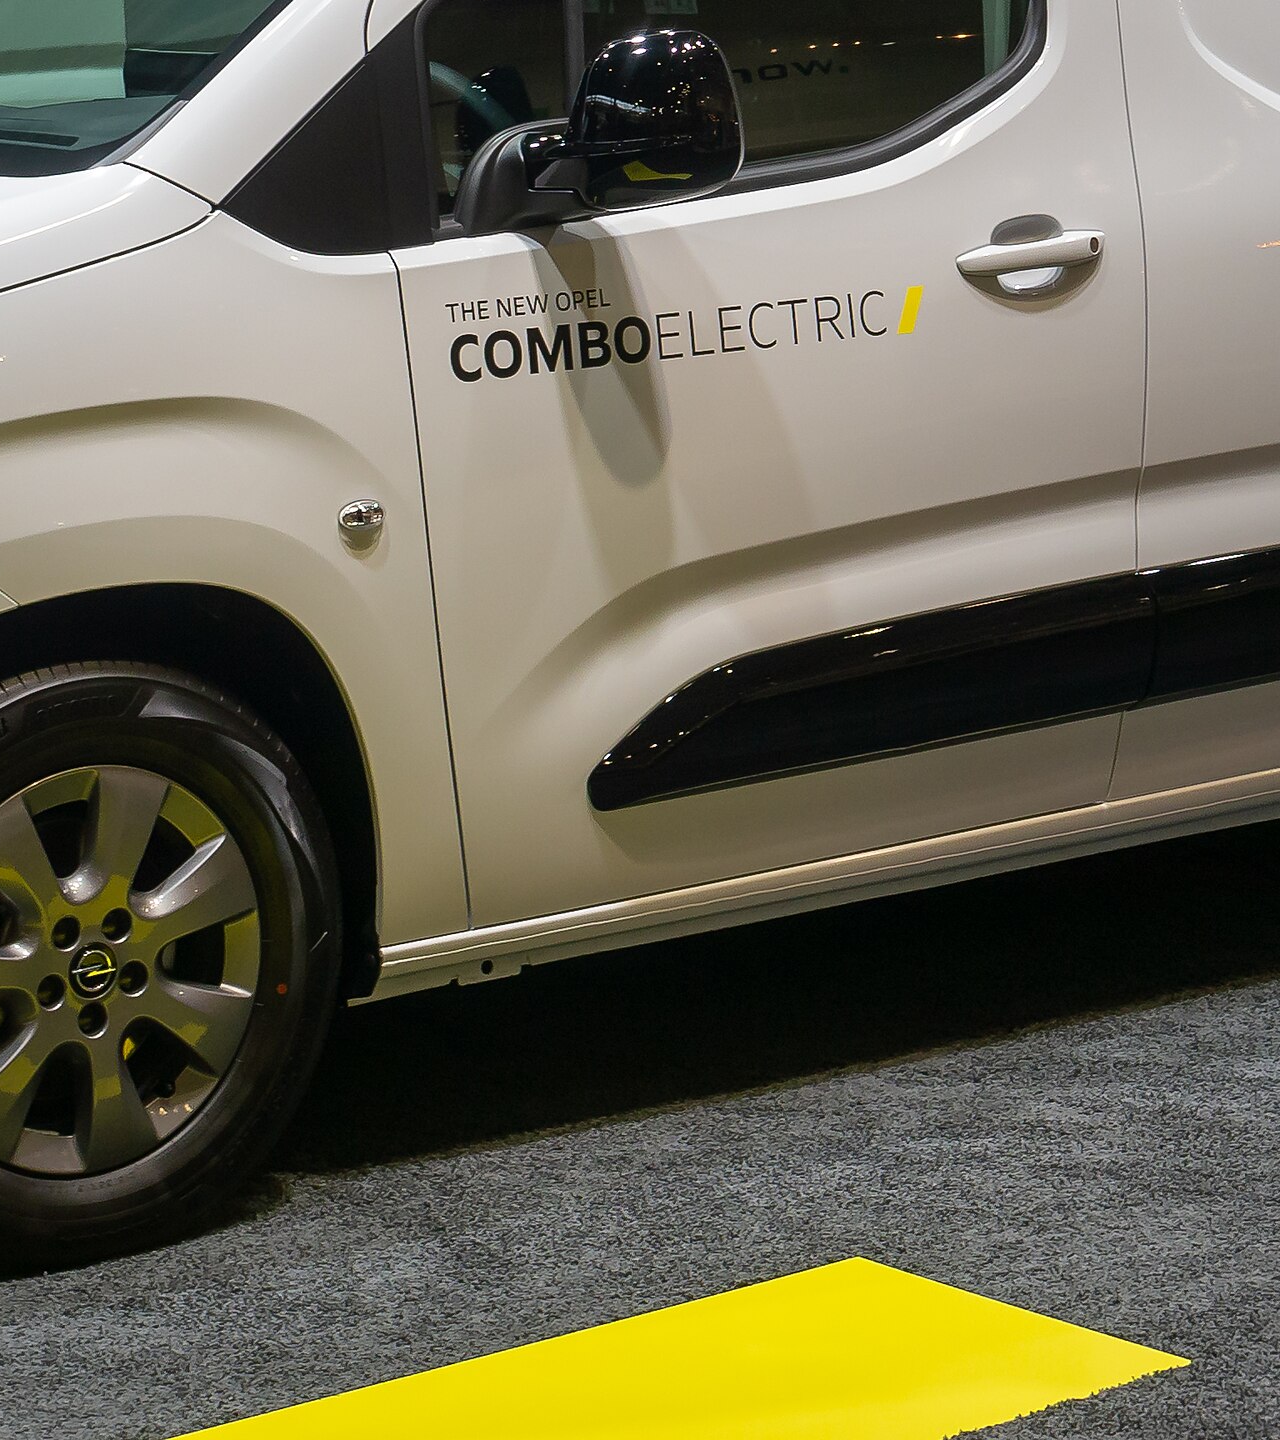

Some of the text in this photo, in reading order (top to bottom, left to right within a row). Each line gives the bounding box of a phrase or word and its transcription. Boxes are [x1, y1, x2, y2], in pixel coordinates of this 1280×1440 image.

[445, 287, 611, 323] THE NEW OPEL
